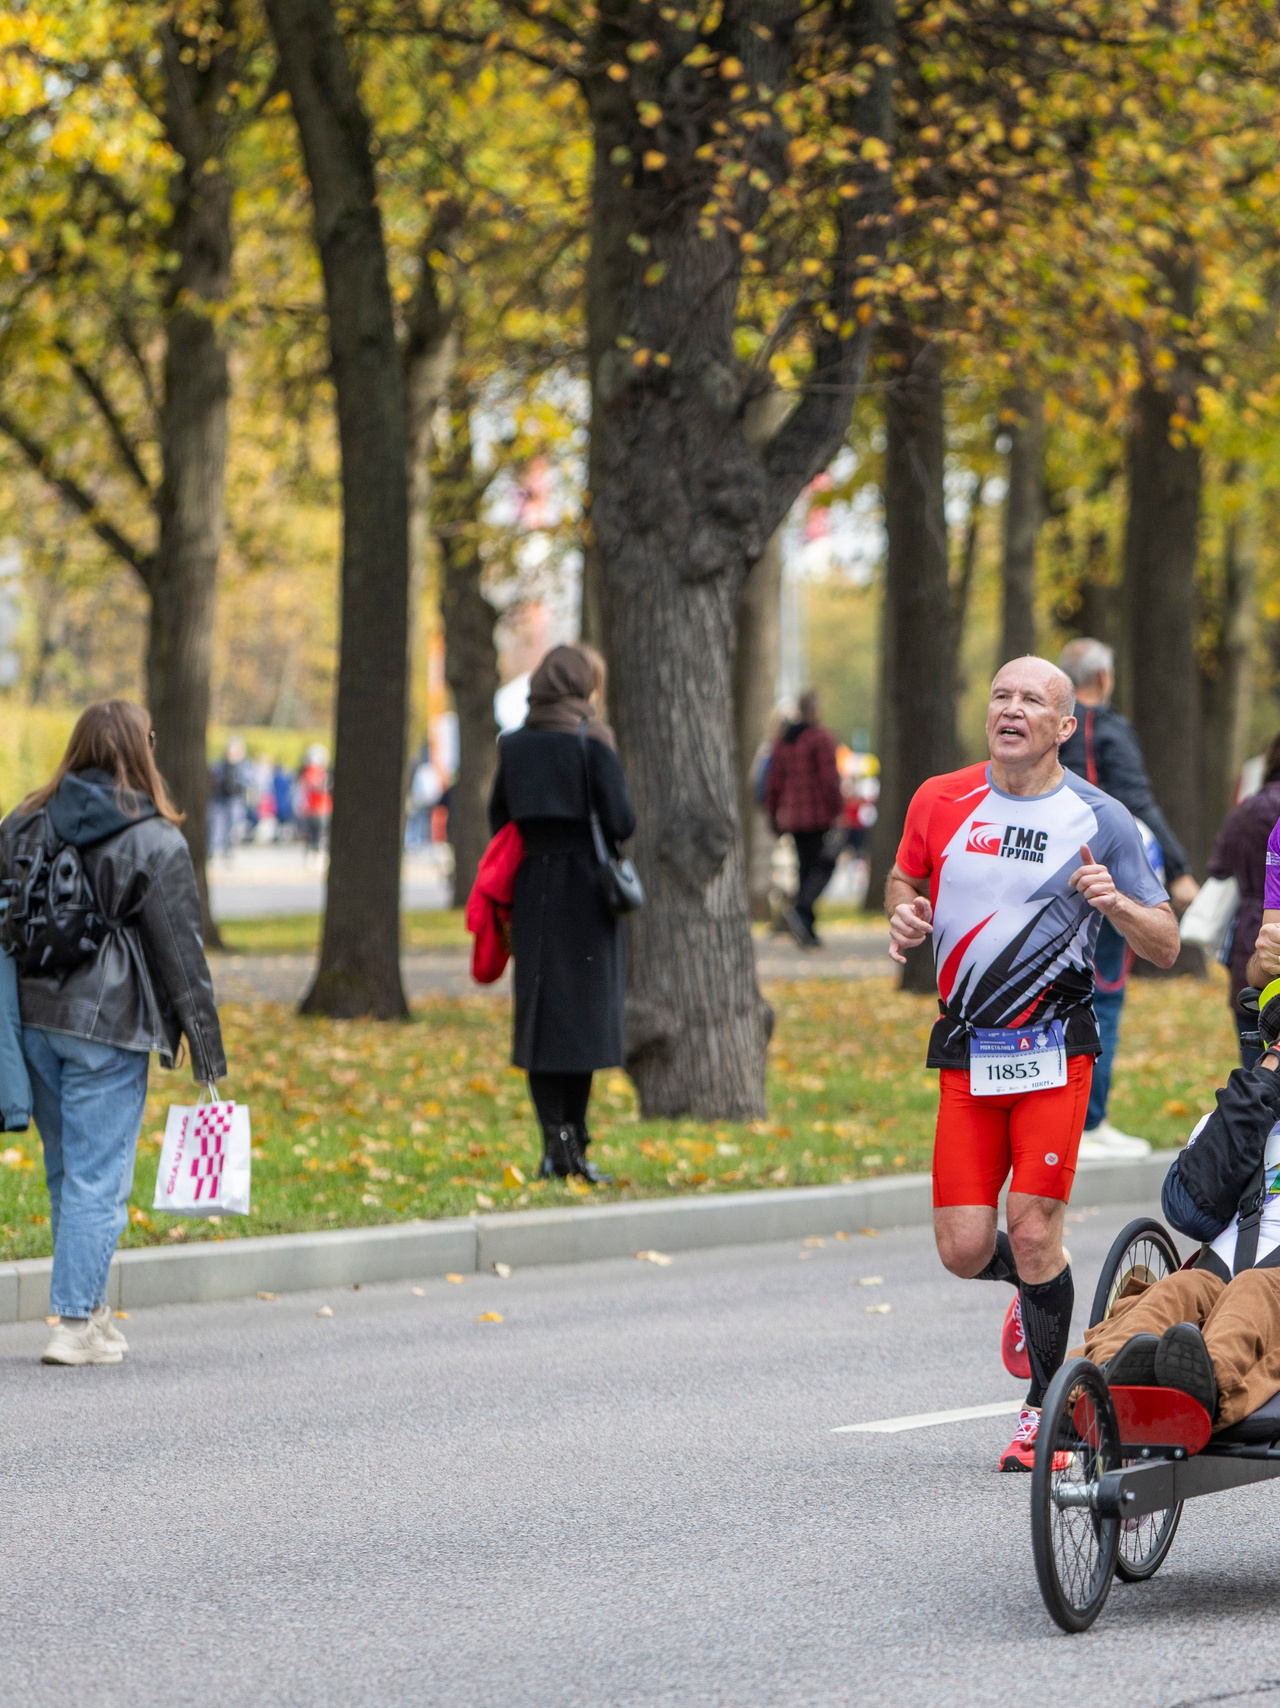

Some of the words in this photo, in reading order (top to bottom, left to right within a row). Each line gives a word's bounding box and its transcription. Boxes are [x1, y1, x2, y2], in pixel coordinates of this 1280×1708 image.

[1002, 825, 1049, 852] ГМС
[1000, 846, 1044, 864] ГРУППА
[986, 1061, 1041, 1081] 11853
